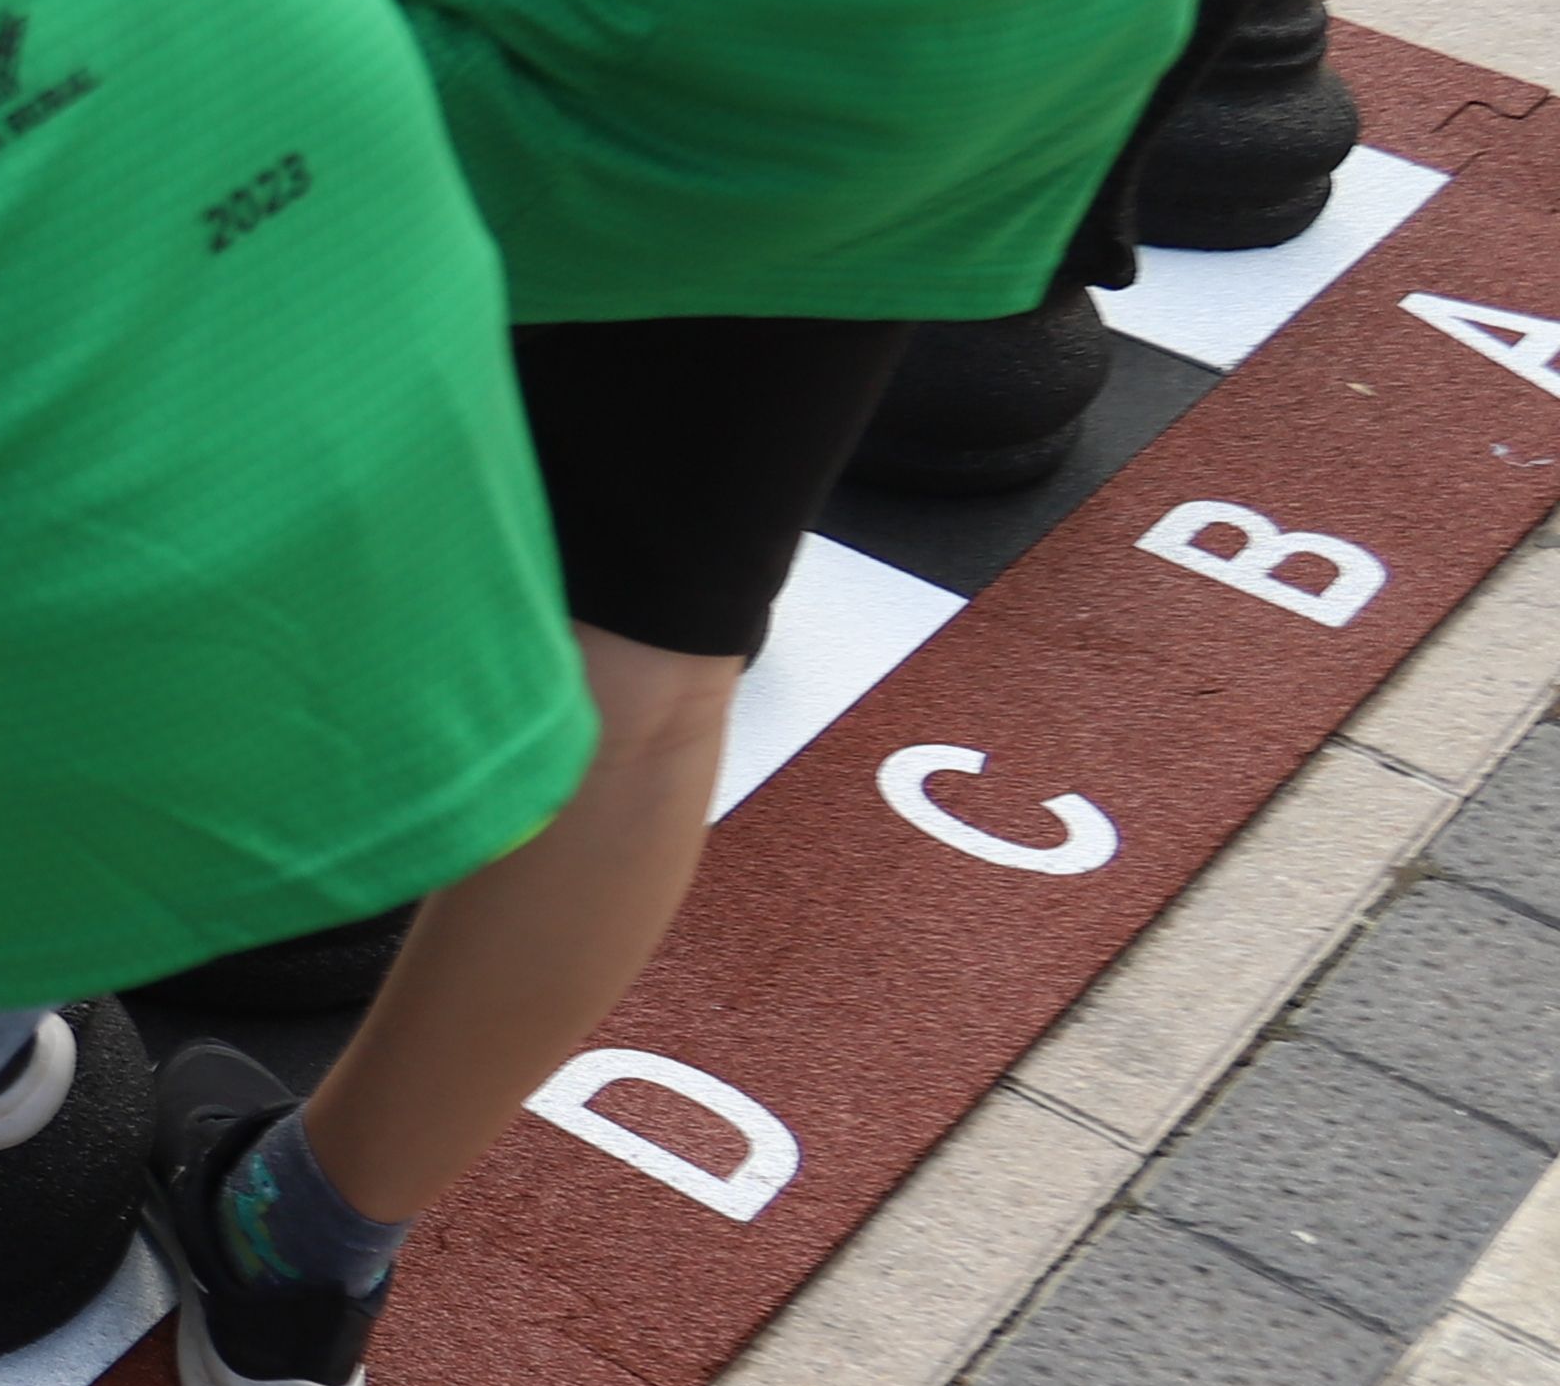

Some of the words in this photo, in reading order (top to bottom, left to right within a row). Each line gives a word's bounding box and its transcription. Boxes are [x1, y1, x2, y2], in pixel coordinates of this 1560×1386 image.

[1396, 293, 1560, 400] A
[1133, 501, 1389, 629] B
[875, 744, 1119, 875] C
[521, 1048, 800, 1222] D
